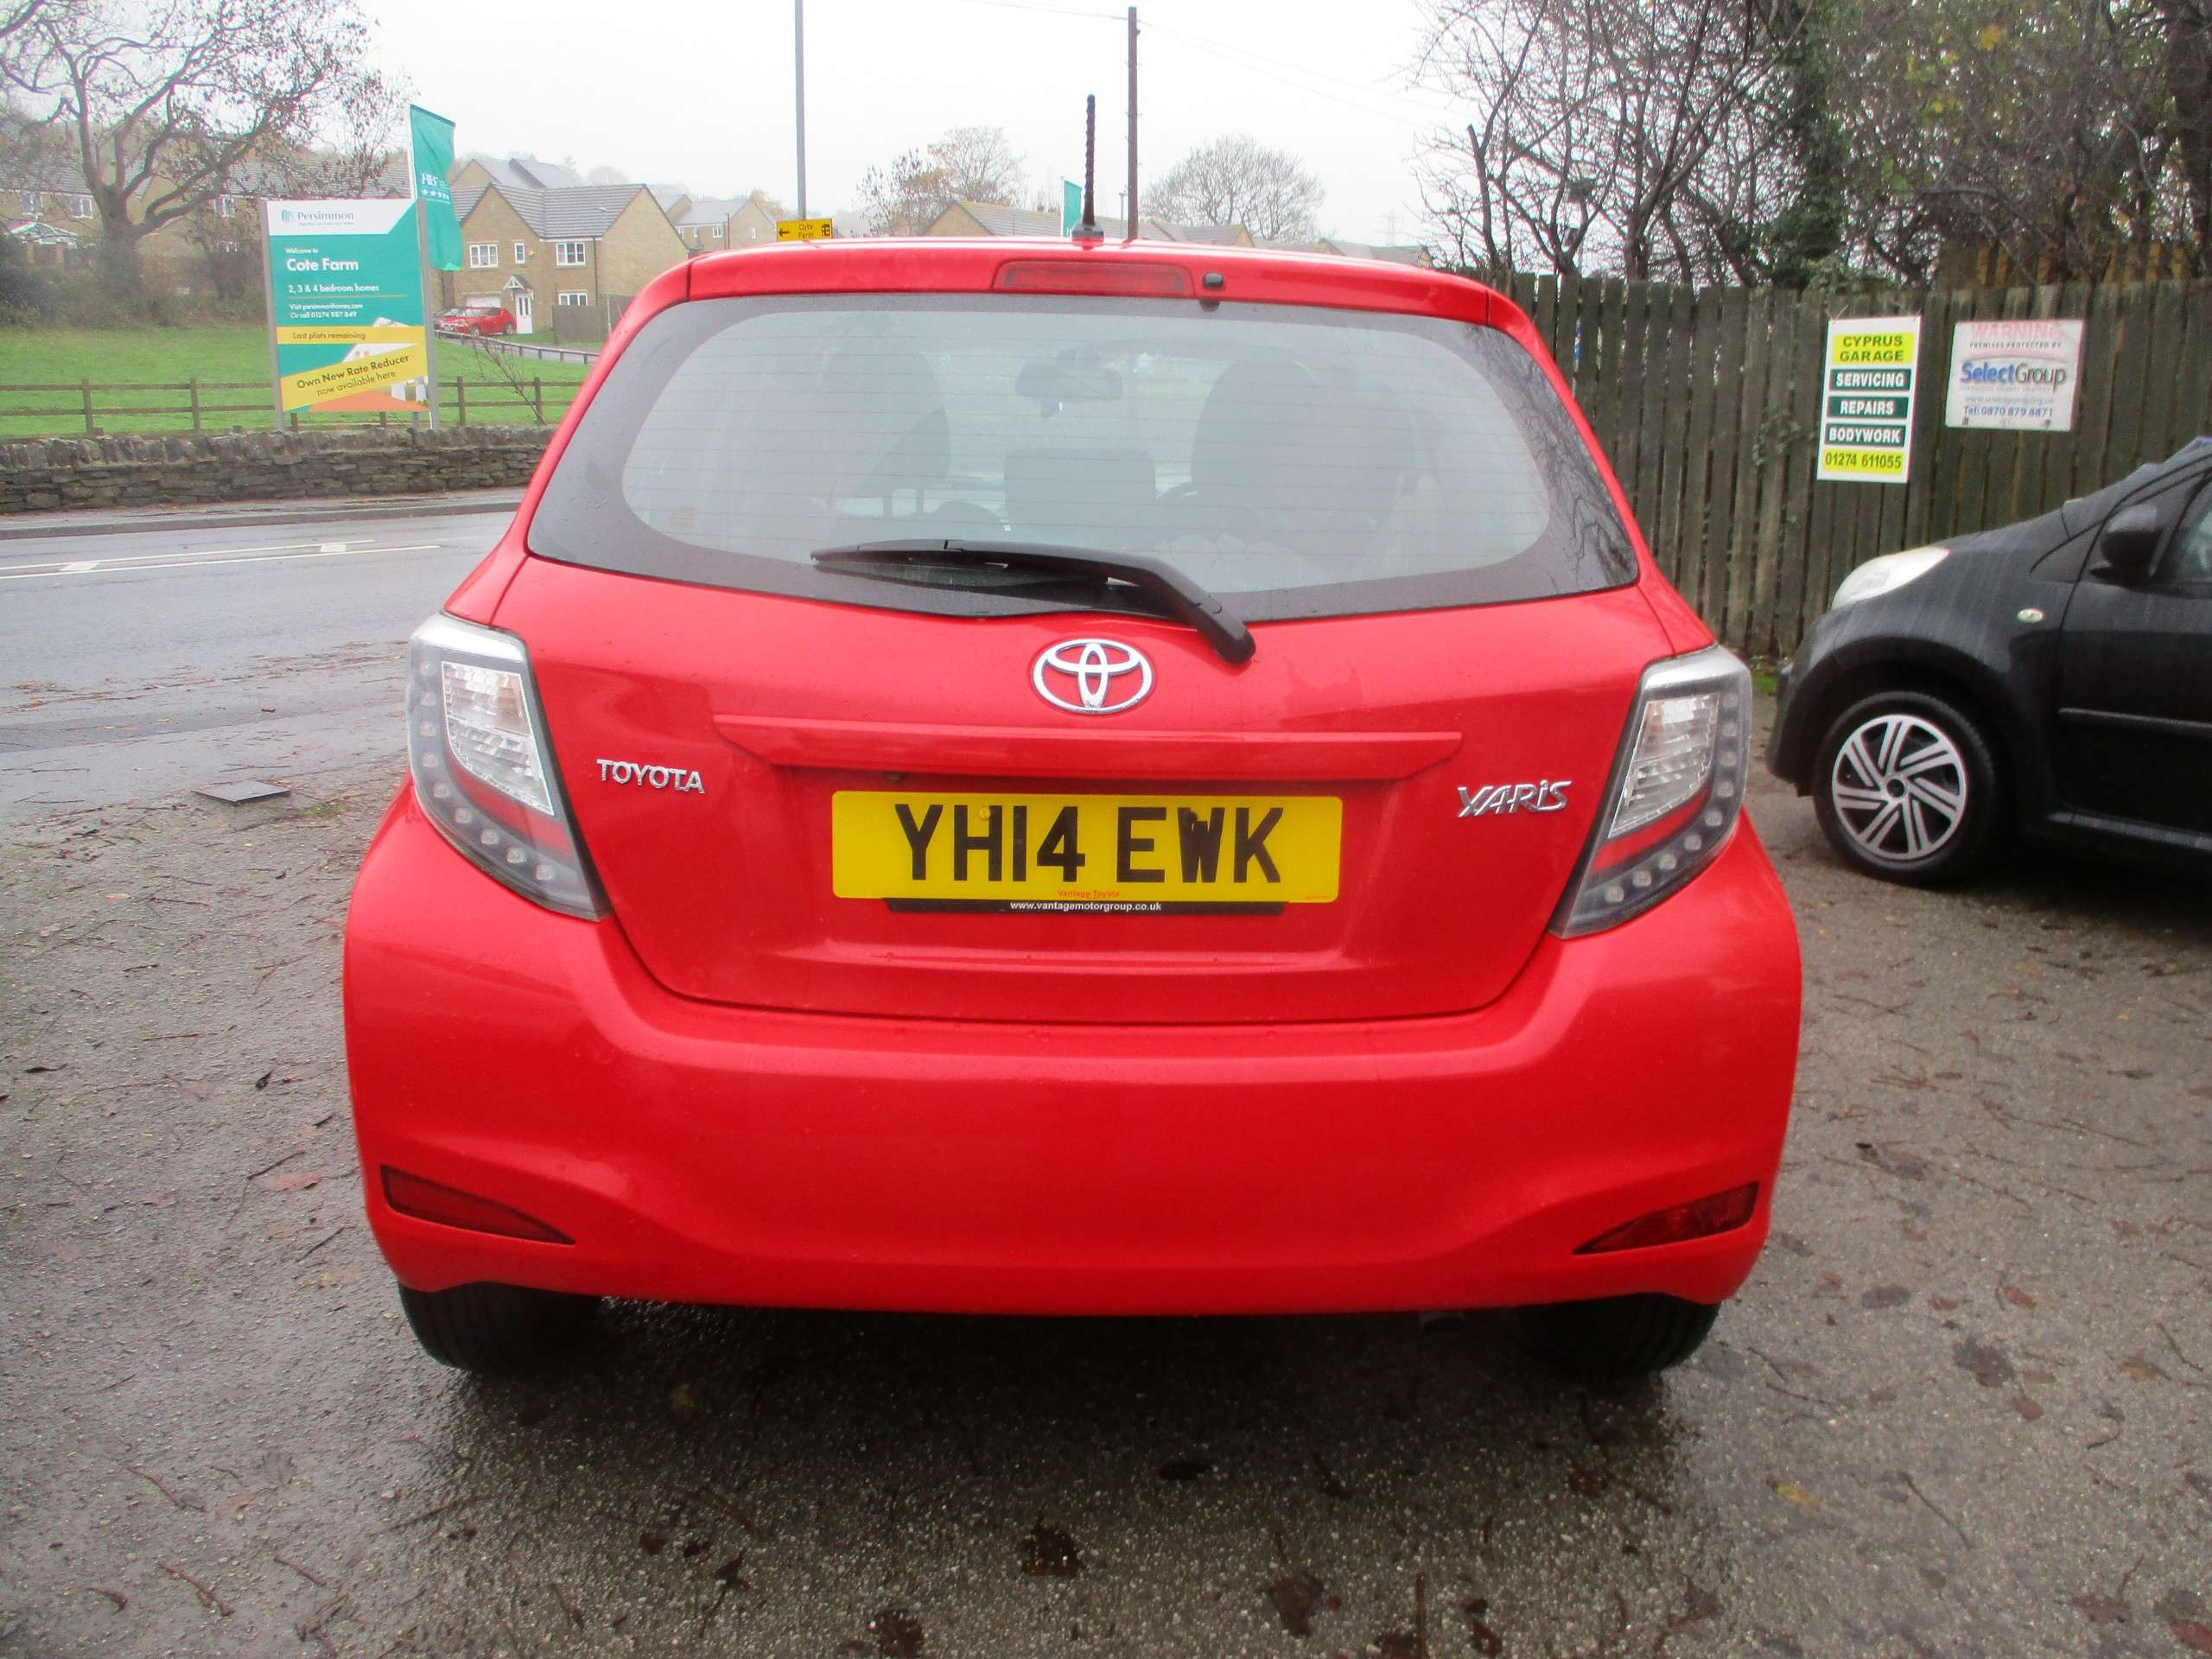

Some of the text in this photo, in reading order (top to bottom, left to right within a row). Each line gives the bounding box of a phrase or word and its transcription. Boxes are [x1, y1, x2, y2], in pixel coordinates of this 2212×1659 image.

[297, 211, 355, 221] Persimmon
[287, 257, 359, 271] Cote Farm
[289, 284, 296, 294] 2,
[297, 284, 303, 293] 3
[305, 284, 312, 293] &
[320, 283, 354, 292] bedroom
[355, 283, 380, 292] homes
[308, 332, 327, 340] plots
[328, 332, 366, 340] remaining
[1842, 334, 1903, 347] CYPRUS
[1840, 350, 1904, 362] GARAGE
[296, 354, 410, 389] Own New Rate Reducer
[1961, 360, 2068, 392] SelectGroup
[317, 371, 397, 396] now available here
[1836, 372, 1905, 388] SERVICING
[1840, 400, 1895, 416] REPAIRS
[1828, 427, 1901, 443] BODYWORK
[1825, 453, 1902, 469] 01274 611055
[596, 759, 705, 794] TOYOTA
[894, 804, 1284, 884] YH14 EWK
[1058, 890, 1121, 899] Vantage Toyota
[1009, 902, 1162, 912] www.vantagemotorgroup.co.uk
